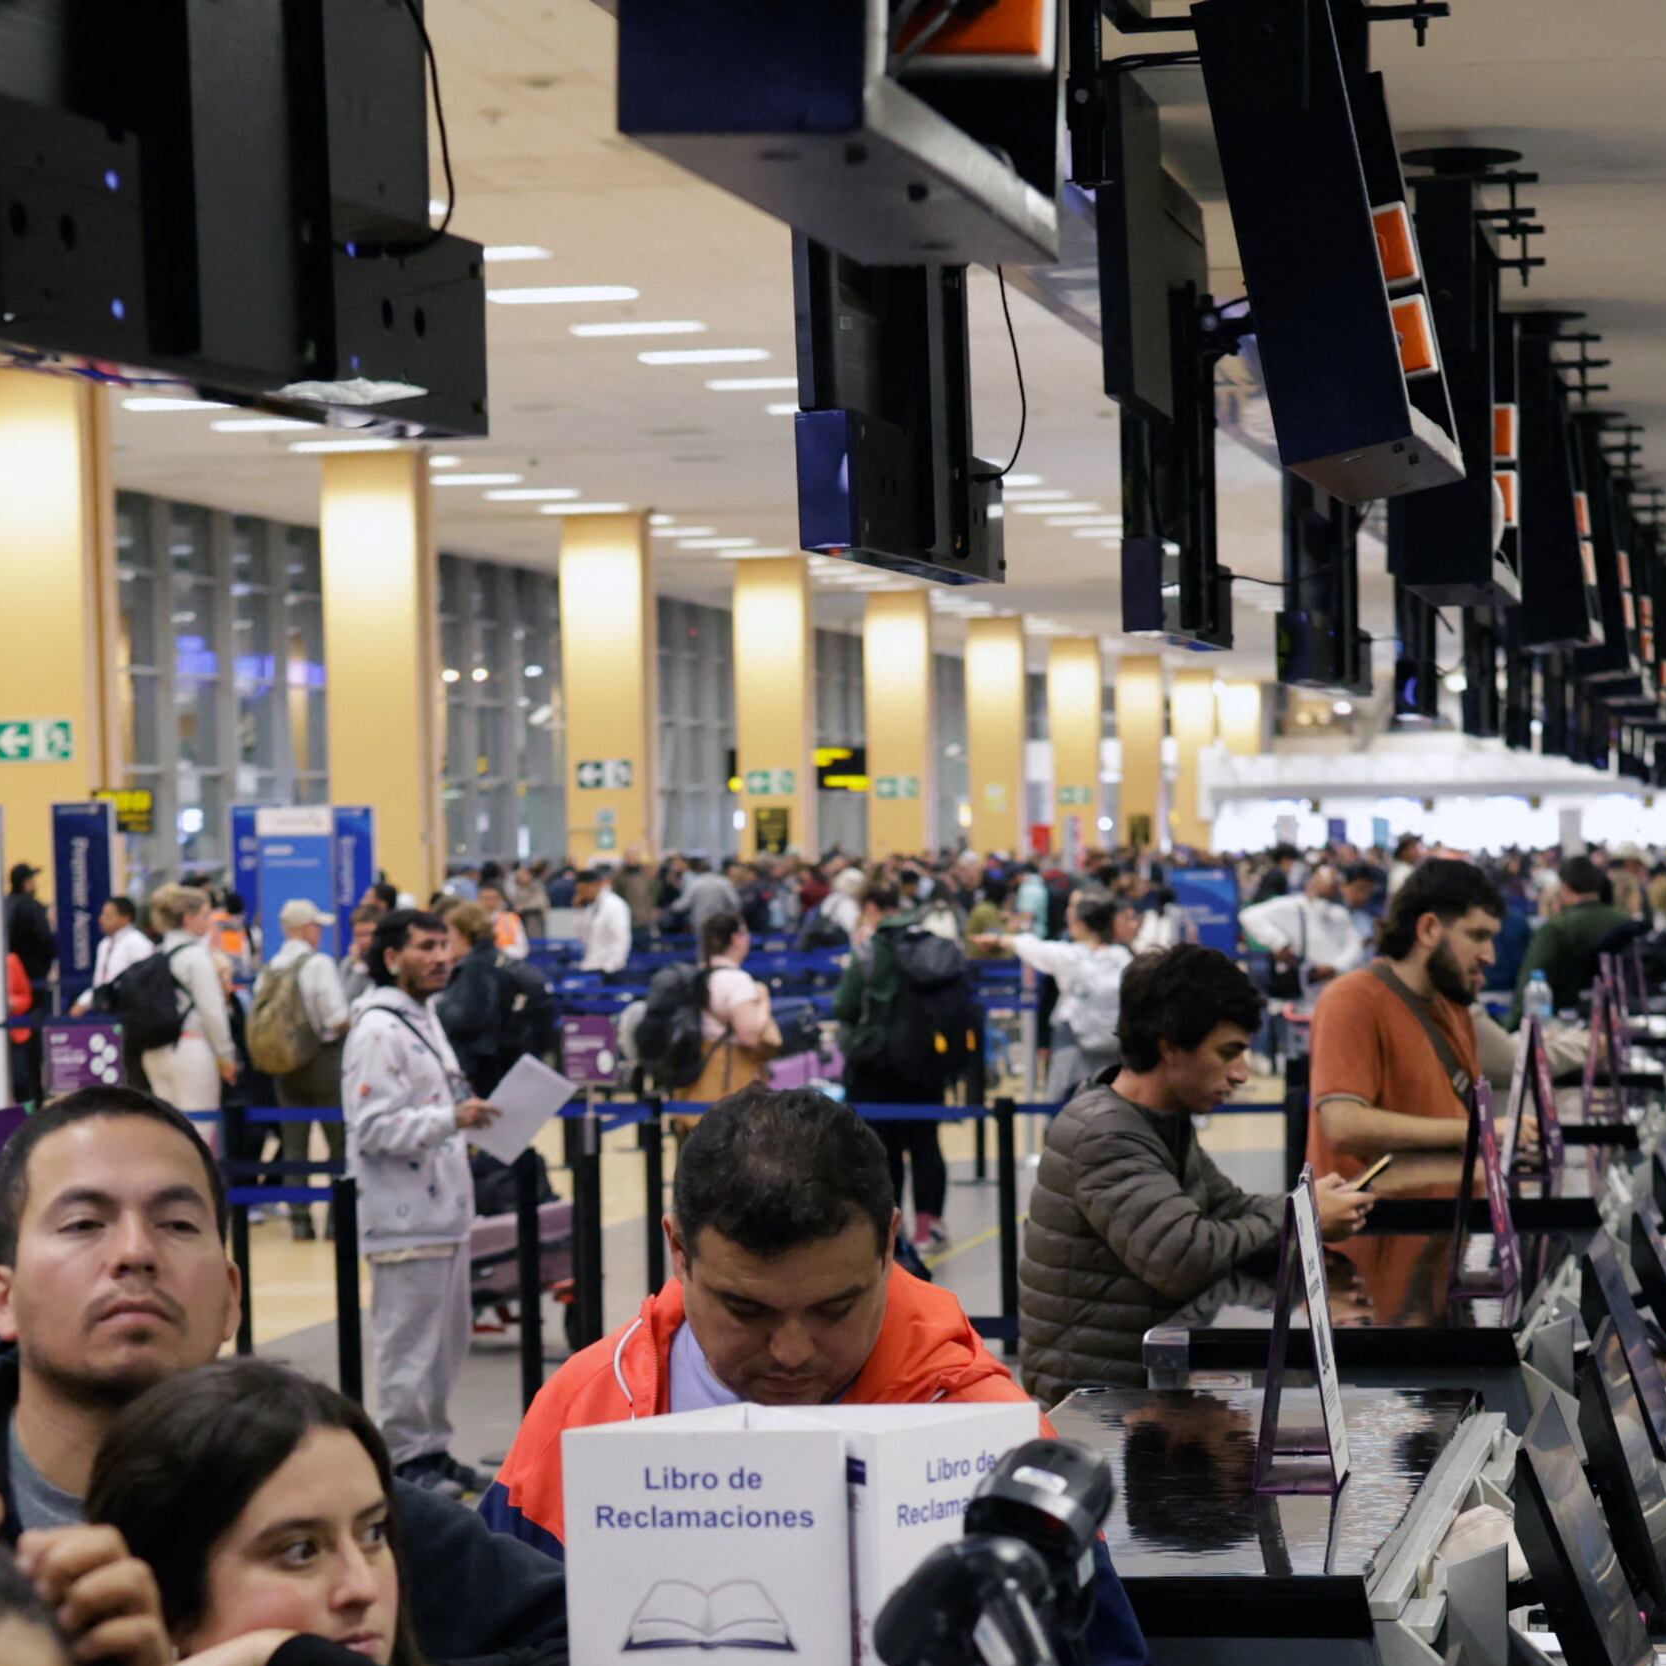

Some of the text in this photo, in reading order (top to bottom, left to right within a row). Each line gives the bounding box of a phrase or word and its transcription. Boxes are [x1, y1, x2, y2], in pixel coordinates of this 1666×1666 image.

[644, 1466, 763, 1490] Libro de
[926, 1450, 997, 1484] Libro de
[595, 1505, 815, 1529] Reclamaciones
